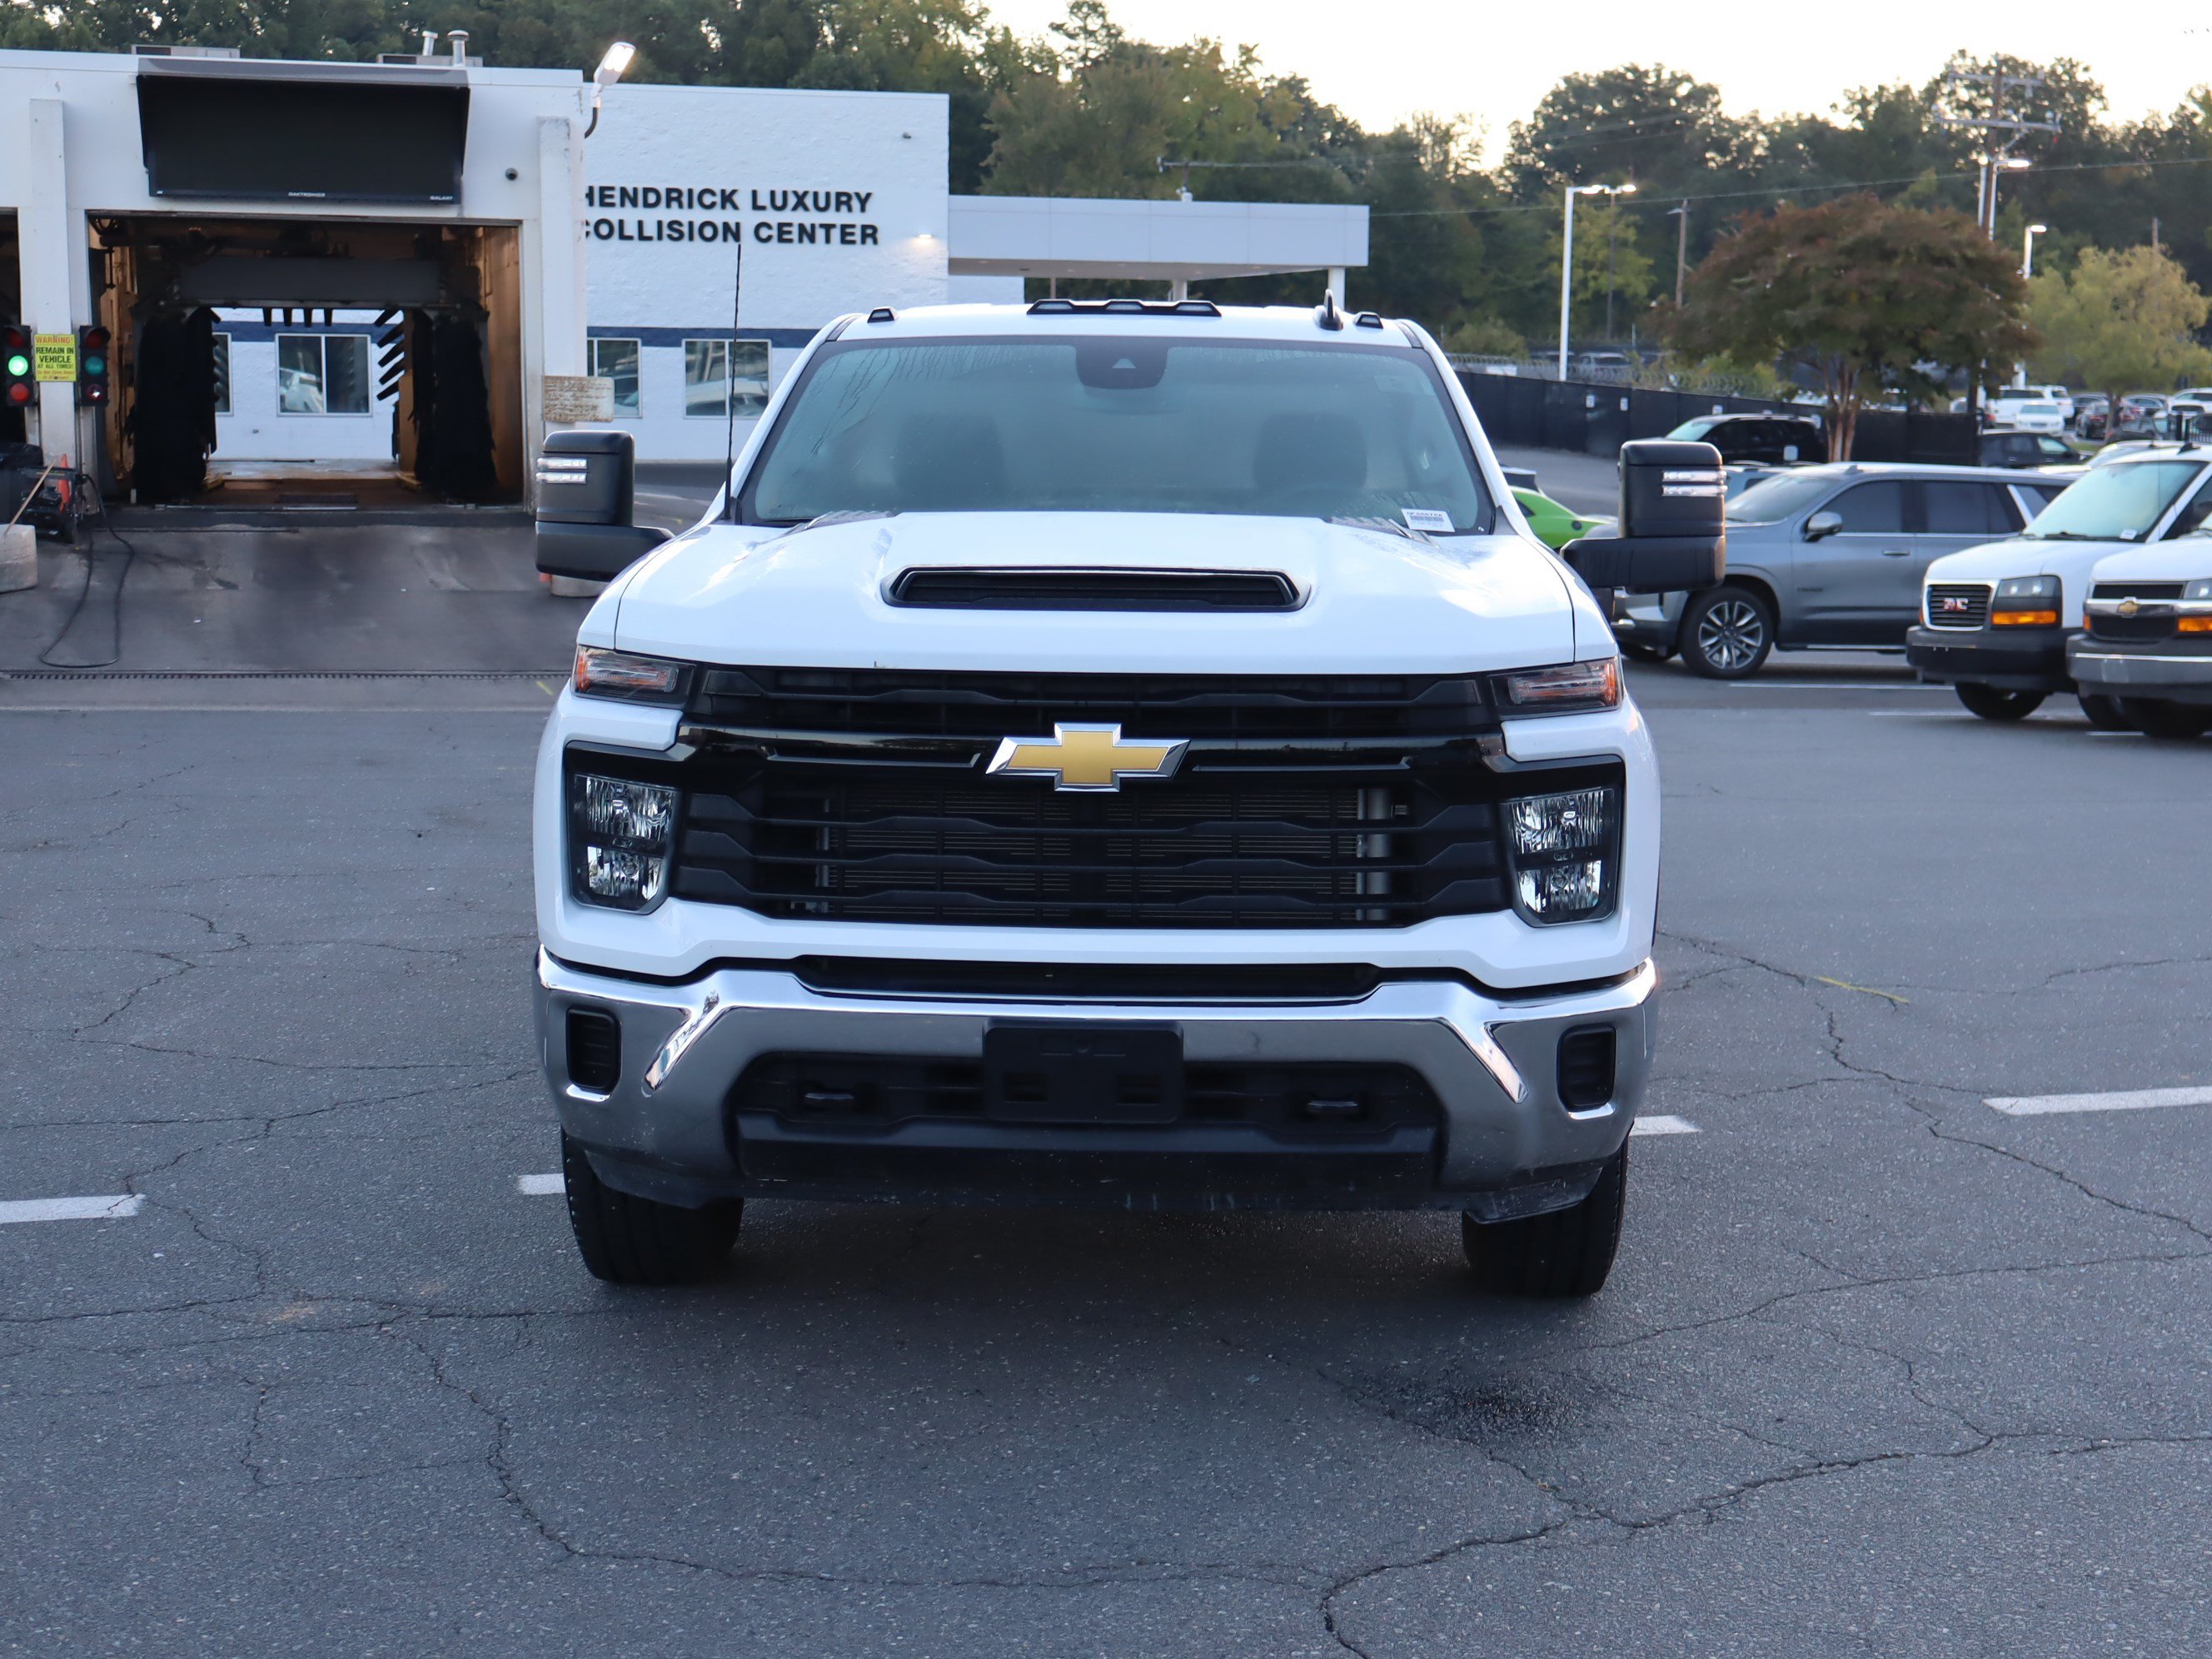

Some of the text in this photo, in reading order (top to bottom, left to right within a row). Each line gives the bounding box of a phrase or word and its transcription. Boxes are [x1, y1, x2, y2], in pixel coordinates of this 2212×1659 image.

[751, 189, 873, 213] LUXURY
[585, 218, 879, 245] OLLISION CENTER
[36, 336, 73, 344] WARNING!
[36, 346, 74, 355] REMAIN IN
[39, 355, 72, 363] VEHICLE
